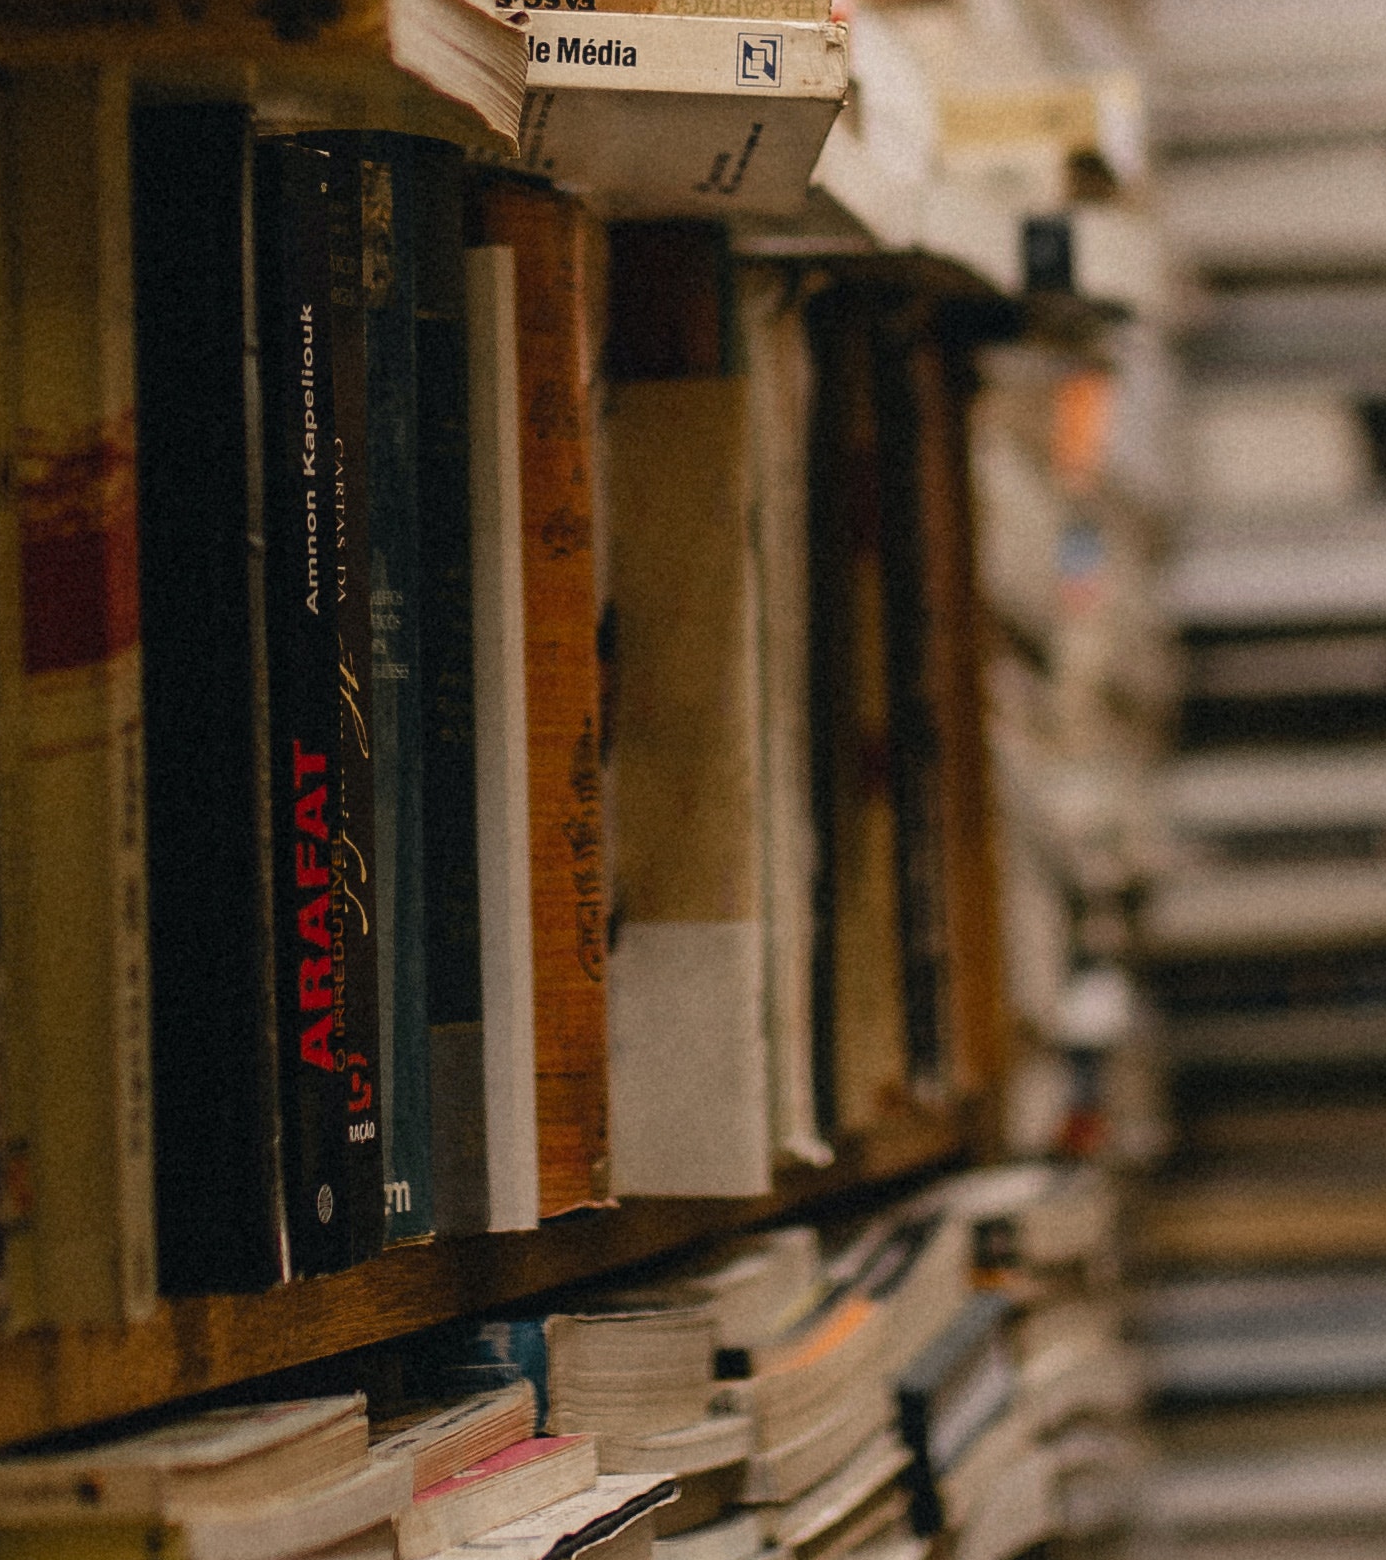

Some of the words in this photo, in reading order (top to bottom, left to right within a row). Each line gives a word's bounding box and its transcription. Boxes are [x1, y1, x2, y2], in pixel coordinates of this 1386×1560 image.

[557, 37, 638, 67] Média
[300, 303, 319, 477] Kapeliouk
[303, 490, 321, 617] Amnon
[333, 436, 347, 551] CARTAS
[334, 564, 348, 604] DA
[293, 737, 335, 1073] ARAFAT
